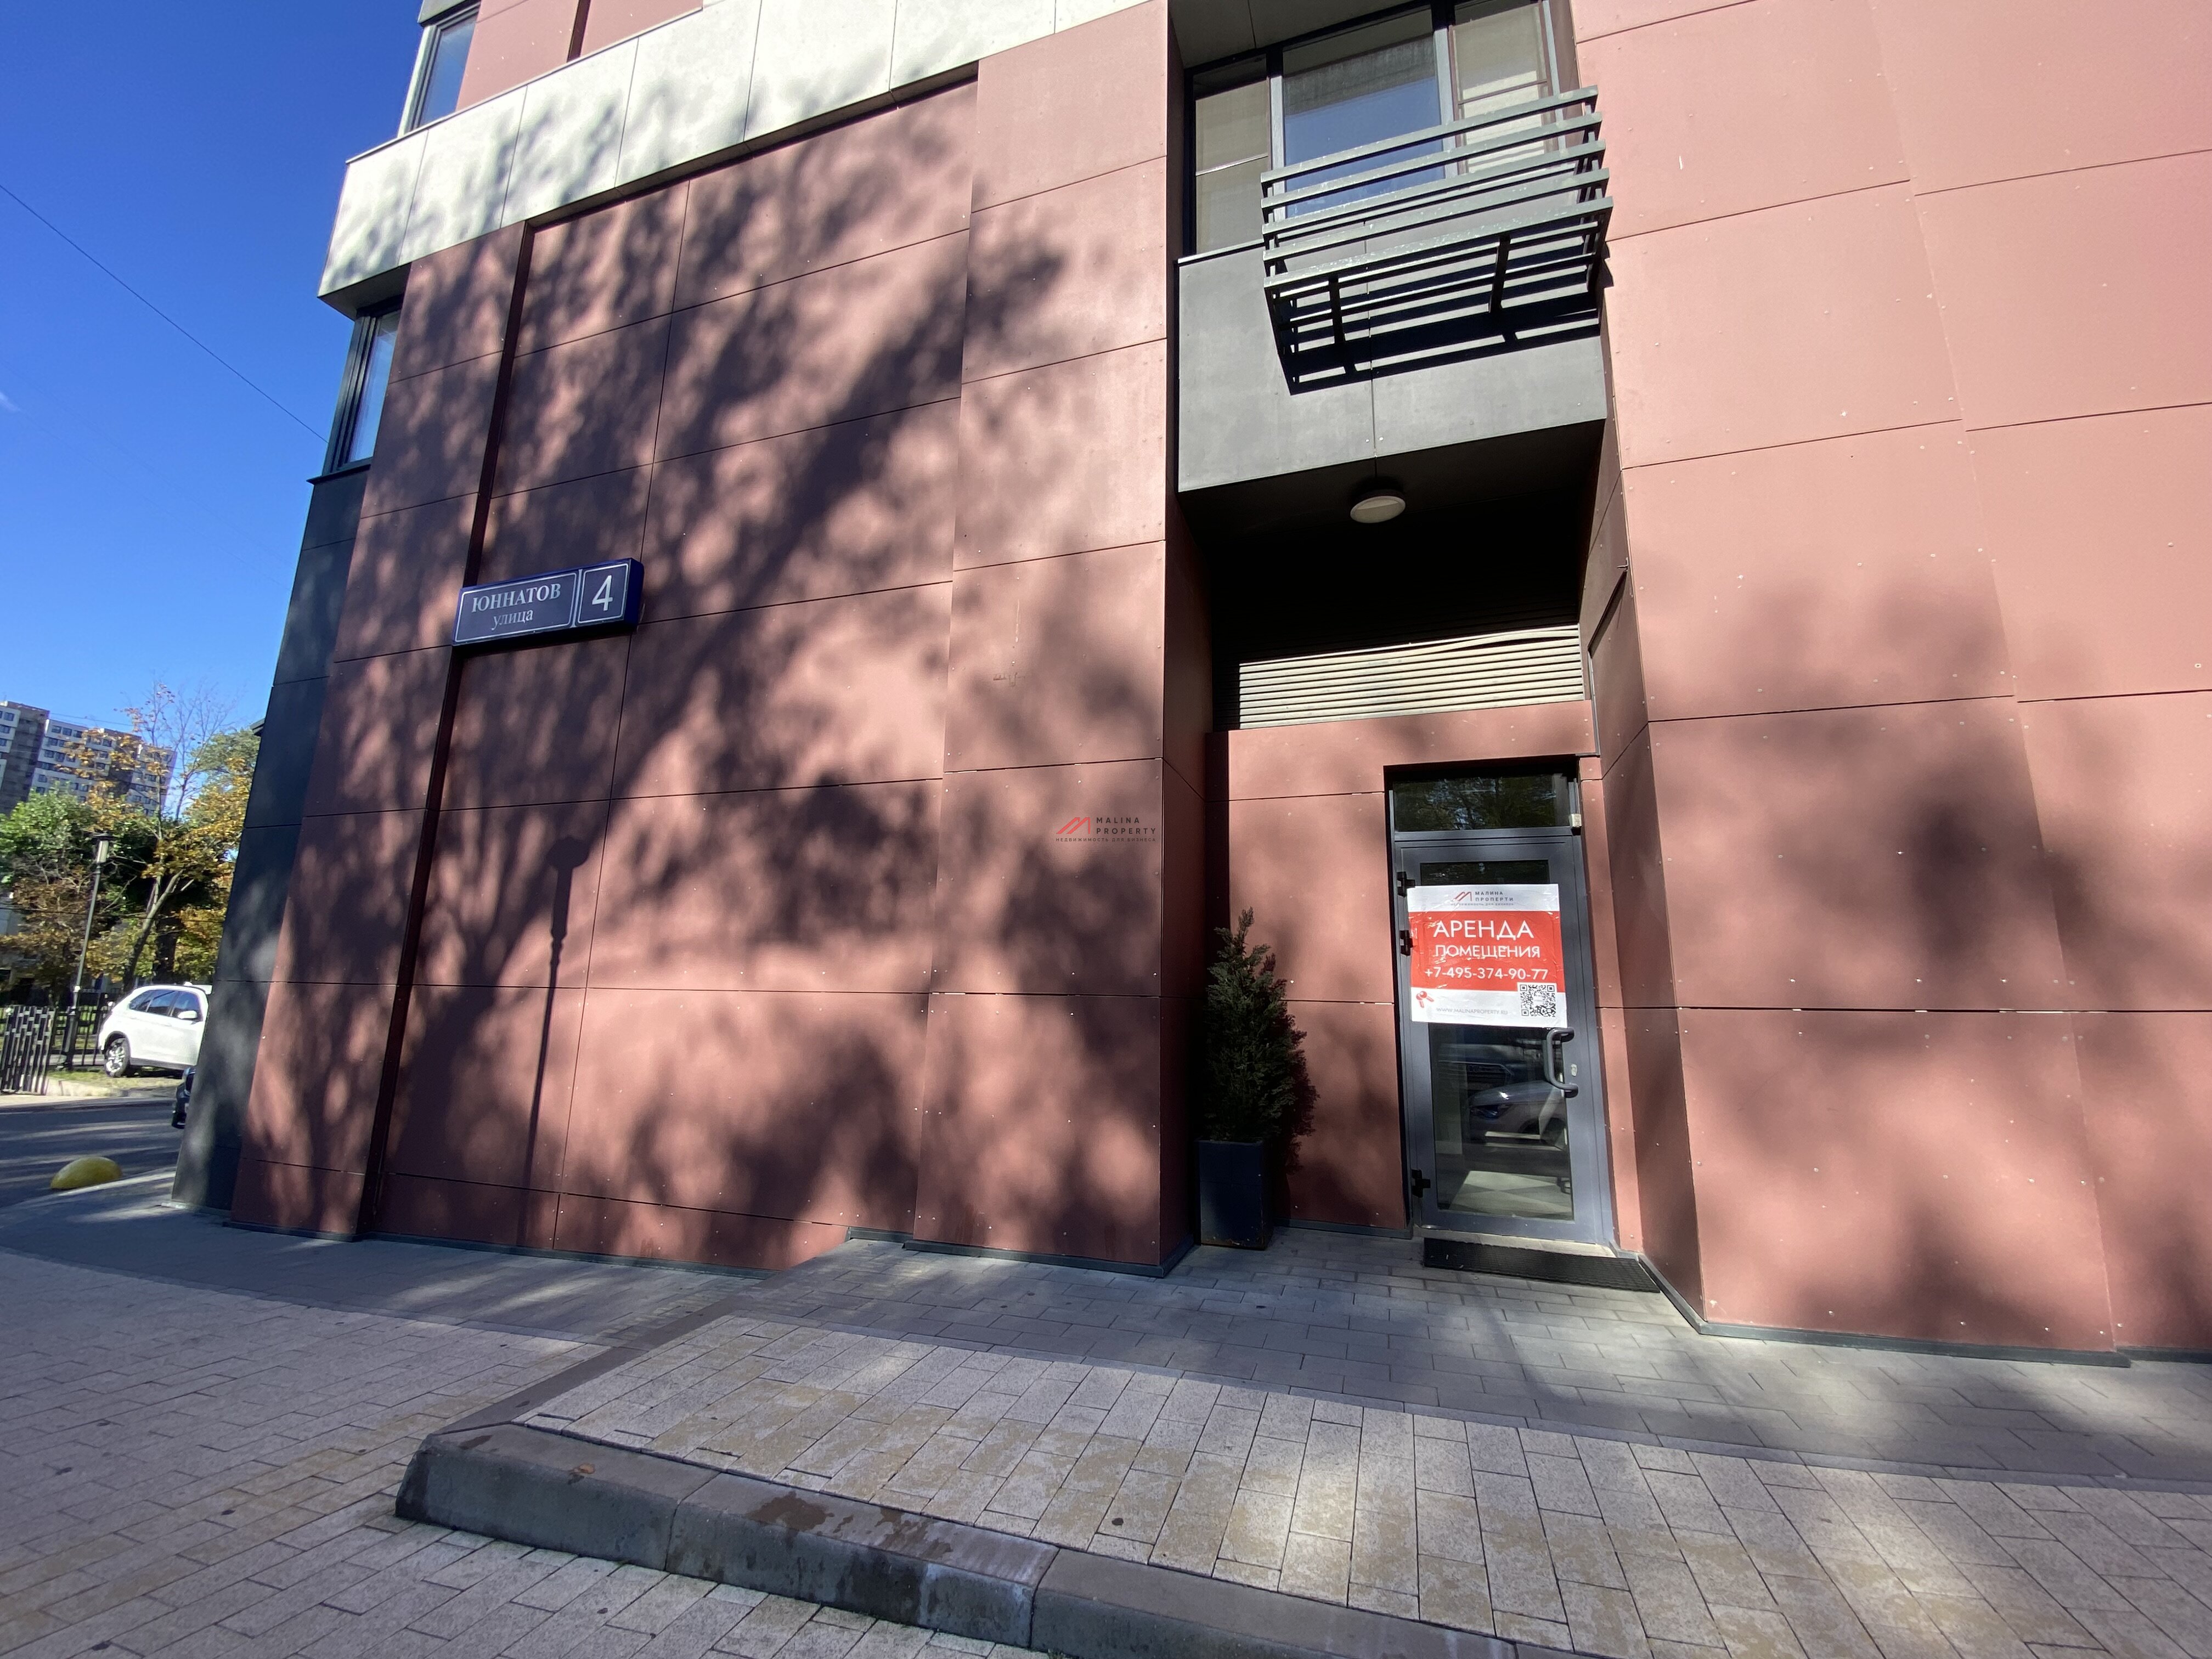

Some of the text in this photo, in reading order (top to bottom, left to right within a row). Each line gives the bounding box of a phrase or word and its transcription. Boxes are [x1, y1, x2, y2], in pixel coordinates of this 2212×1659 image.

[471, 583, 561, 613] ЮННАТОВ
[592, 575, 613, 612] 4
[491, 609, 534, 631] улица
[1433, 920, 1534, 941] АРЕНДА
[1434, 944, 1541, 958] ПОМЕЩЕНИЯ
[1424, 966, 1549, 980] +7-495-374-90-77
